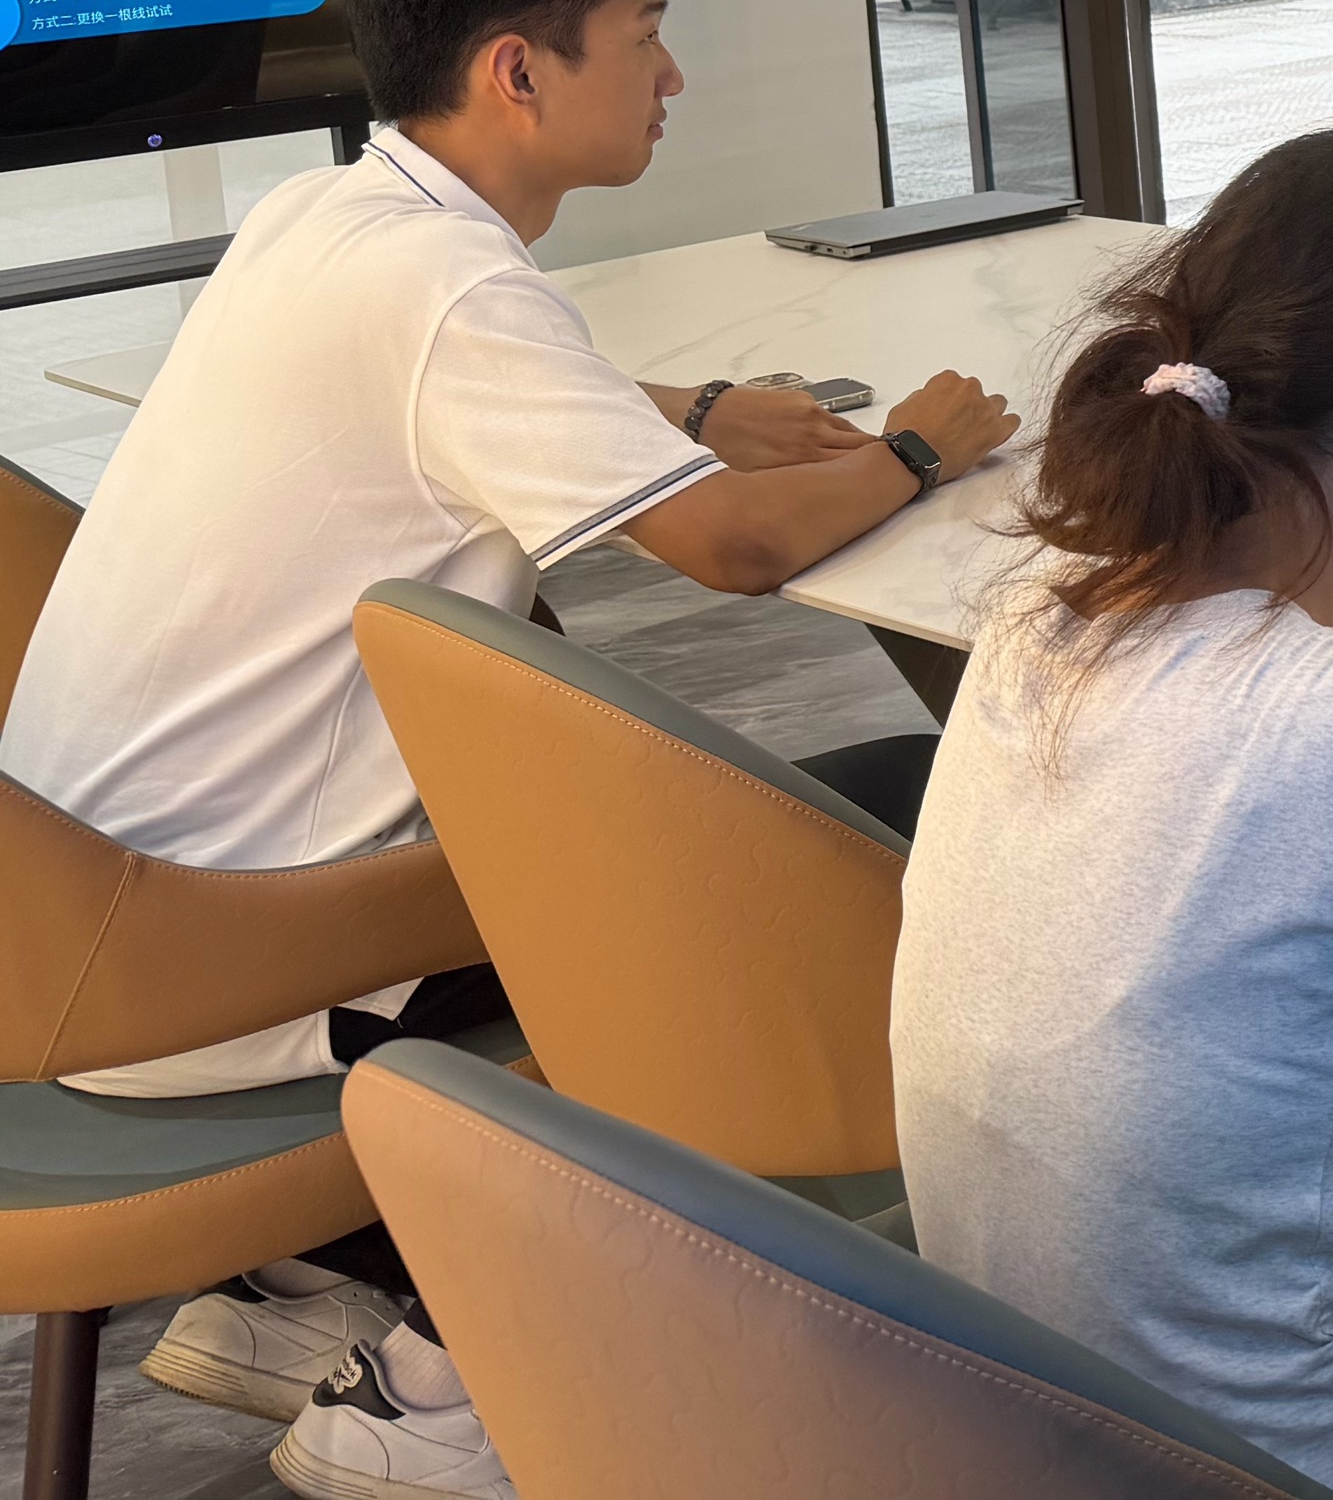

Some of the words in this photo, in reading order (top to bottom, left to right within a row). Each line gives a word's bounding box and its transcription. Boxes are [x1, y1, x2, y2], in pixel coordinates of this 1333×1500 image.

[32, 4, 173, 31] 方式二:更换一根线试试
